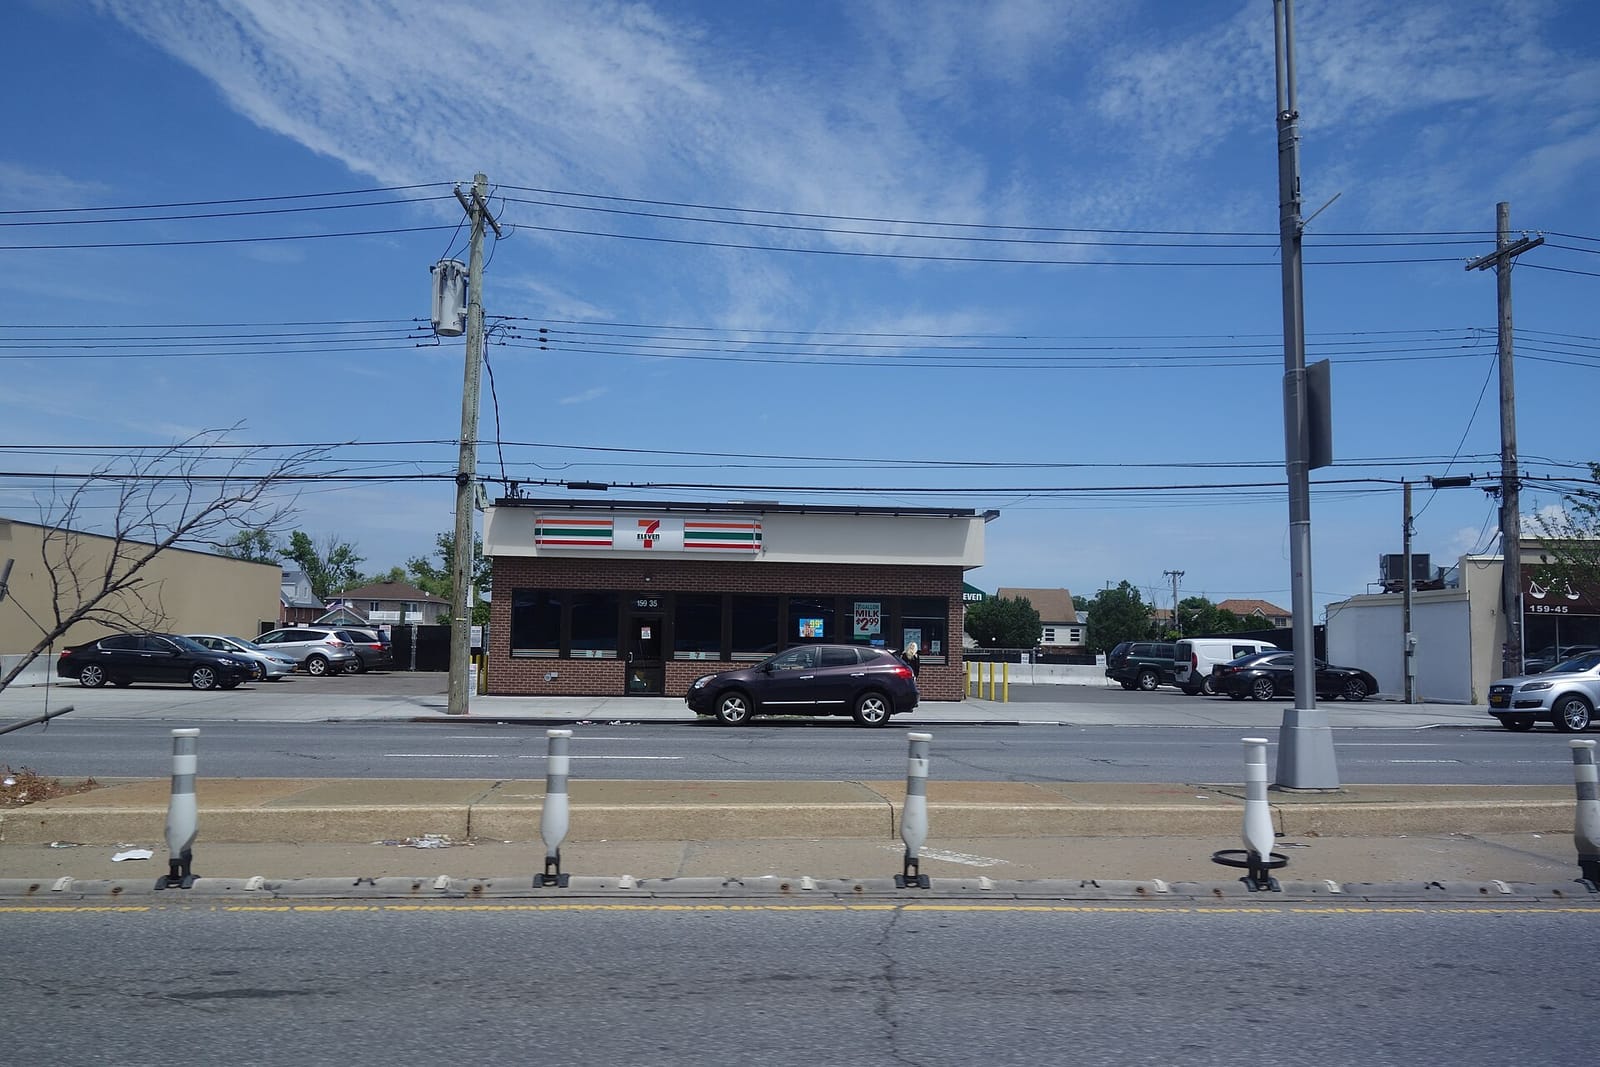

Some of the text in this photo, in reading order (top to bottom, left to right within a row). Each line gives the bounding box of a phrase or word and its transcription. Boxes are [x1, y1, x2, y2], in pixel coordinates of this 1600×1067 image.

[637, 519, 660, 548] 7
[637, 599, 658, 607] 159 35
[1530, 605, 1569, 613] 159-45
[855, 610, 879, 618] MILK
